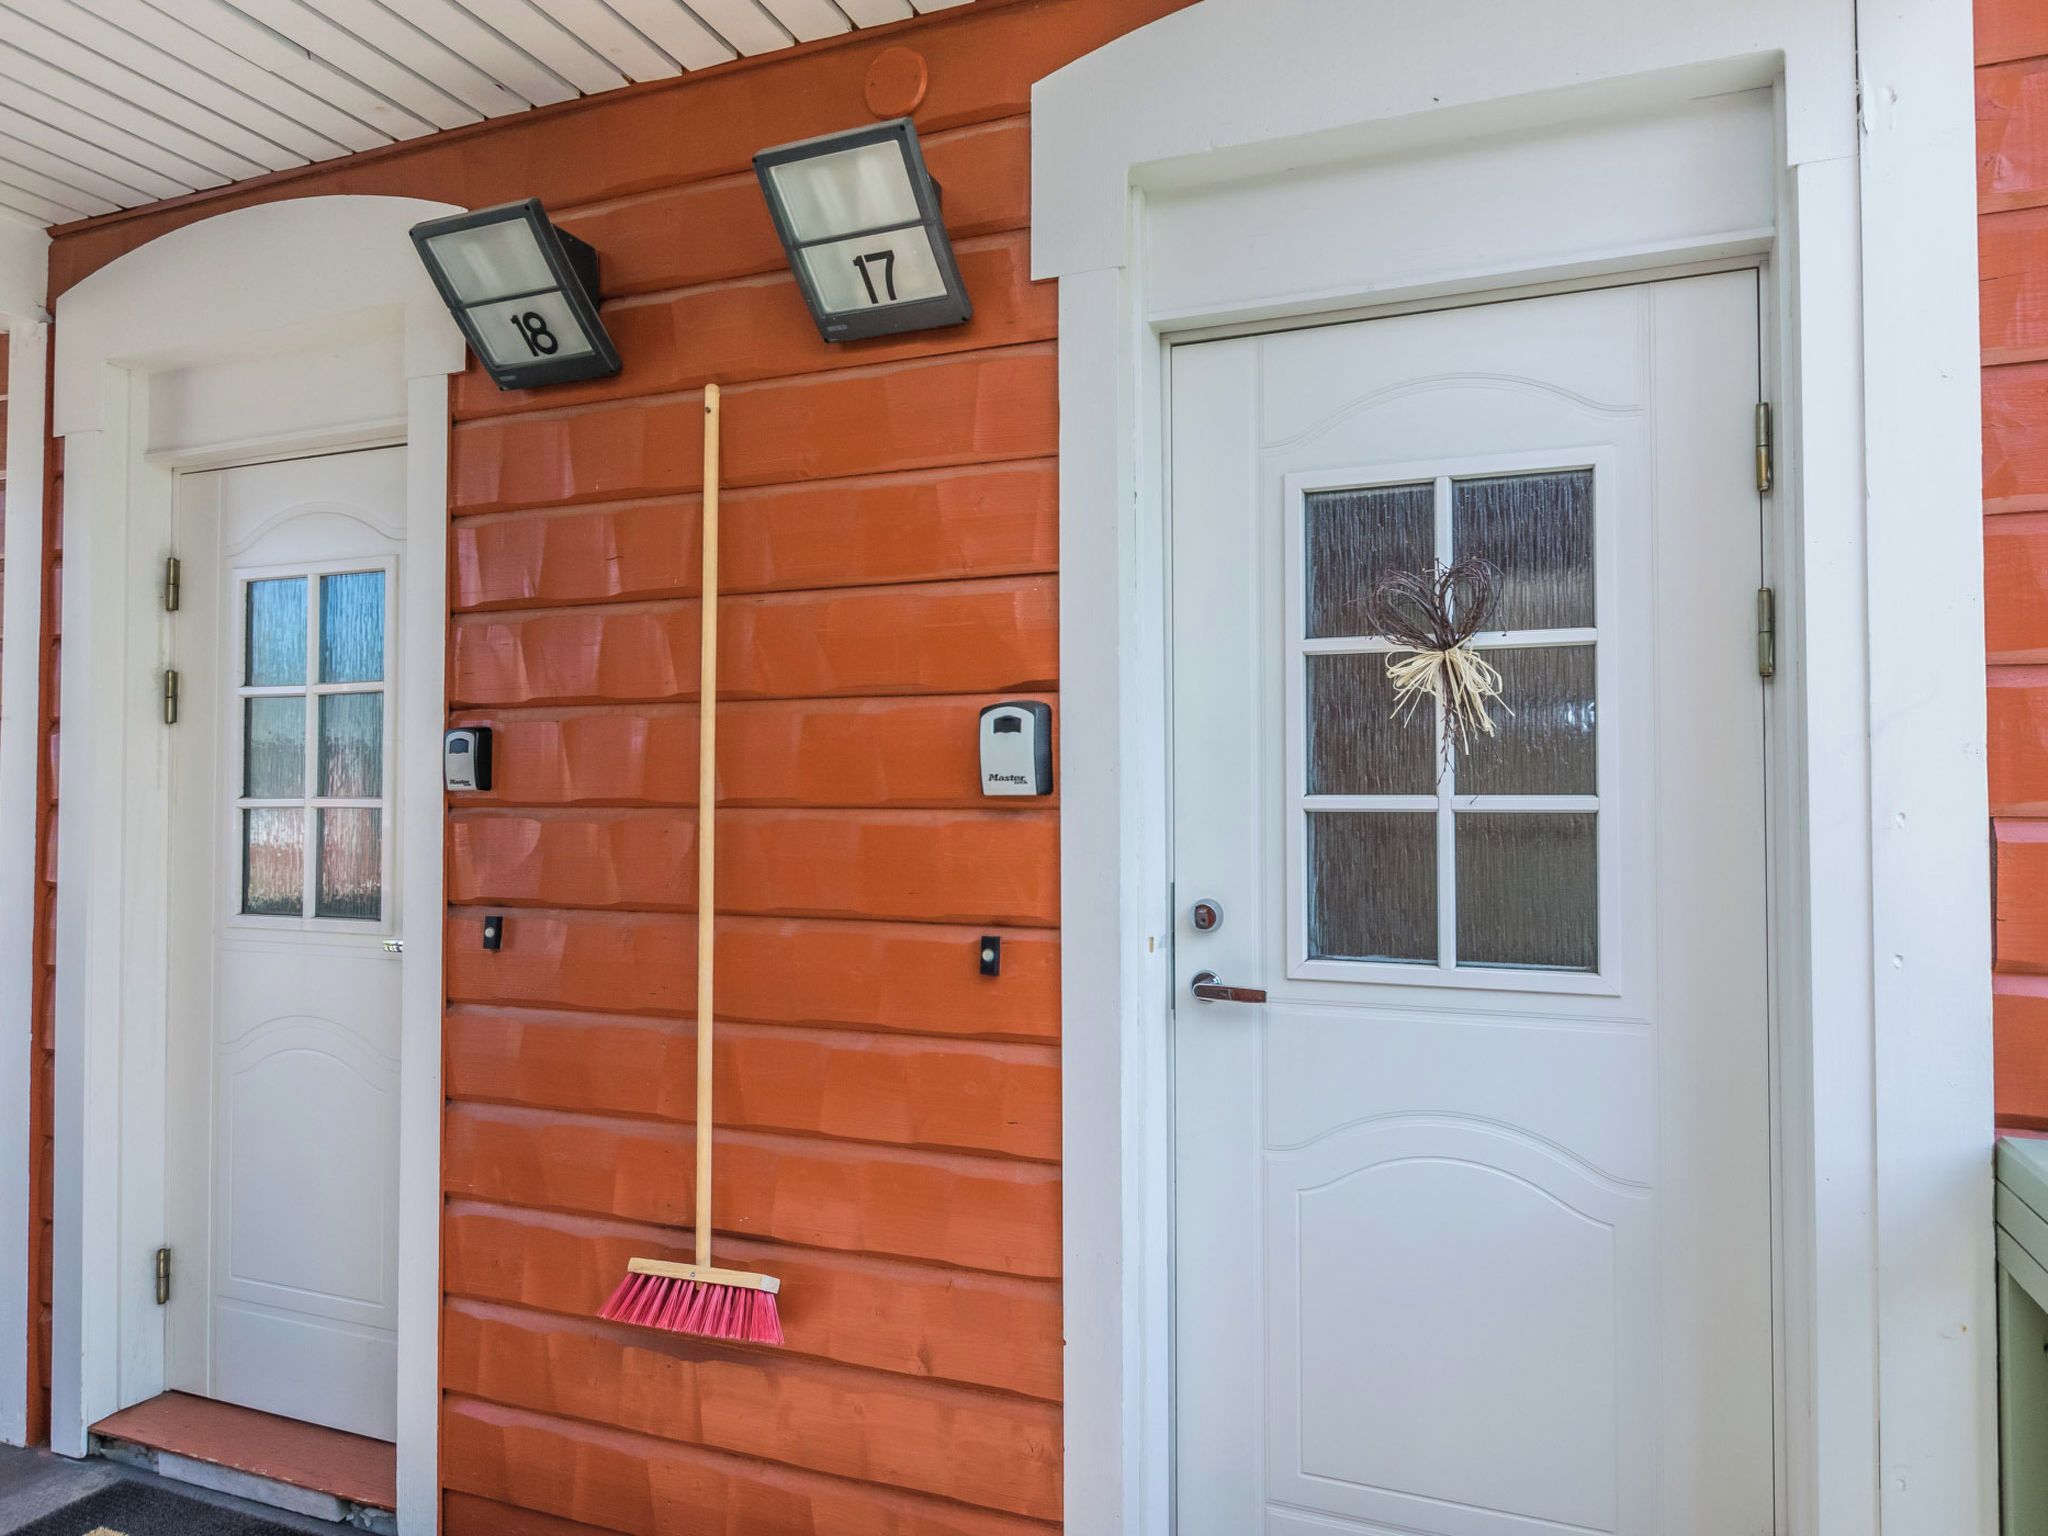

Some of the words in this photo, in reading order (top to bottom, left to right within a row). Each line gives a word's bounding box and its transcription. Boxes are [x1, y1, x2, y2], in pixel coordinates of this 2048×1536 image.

[852, 249, 897, 304] 17
[510, 311, 559, 357] 18
[988, 773, 1025, 782] Master
